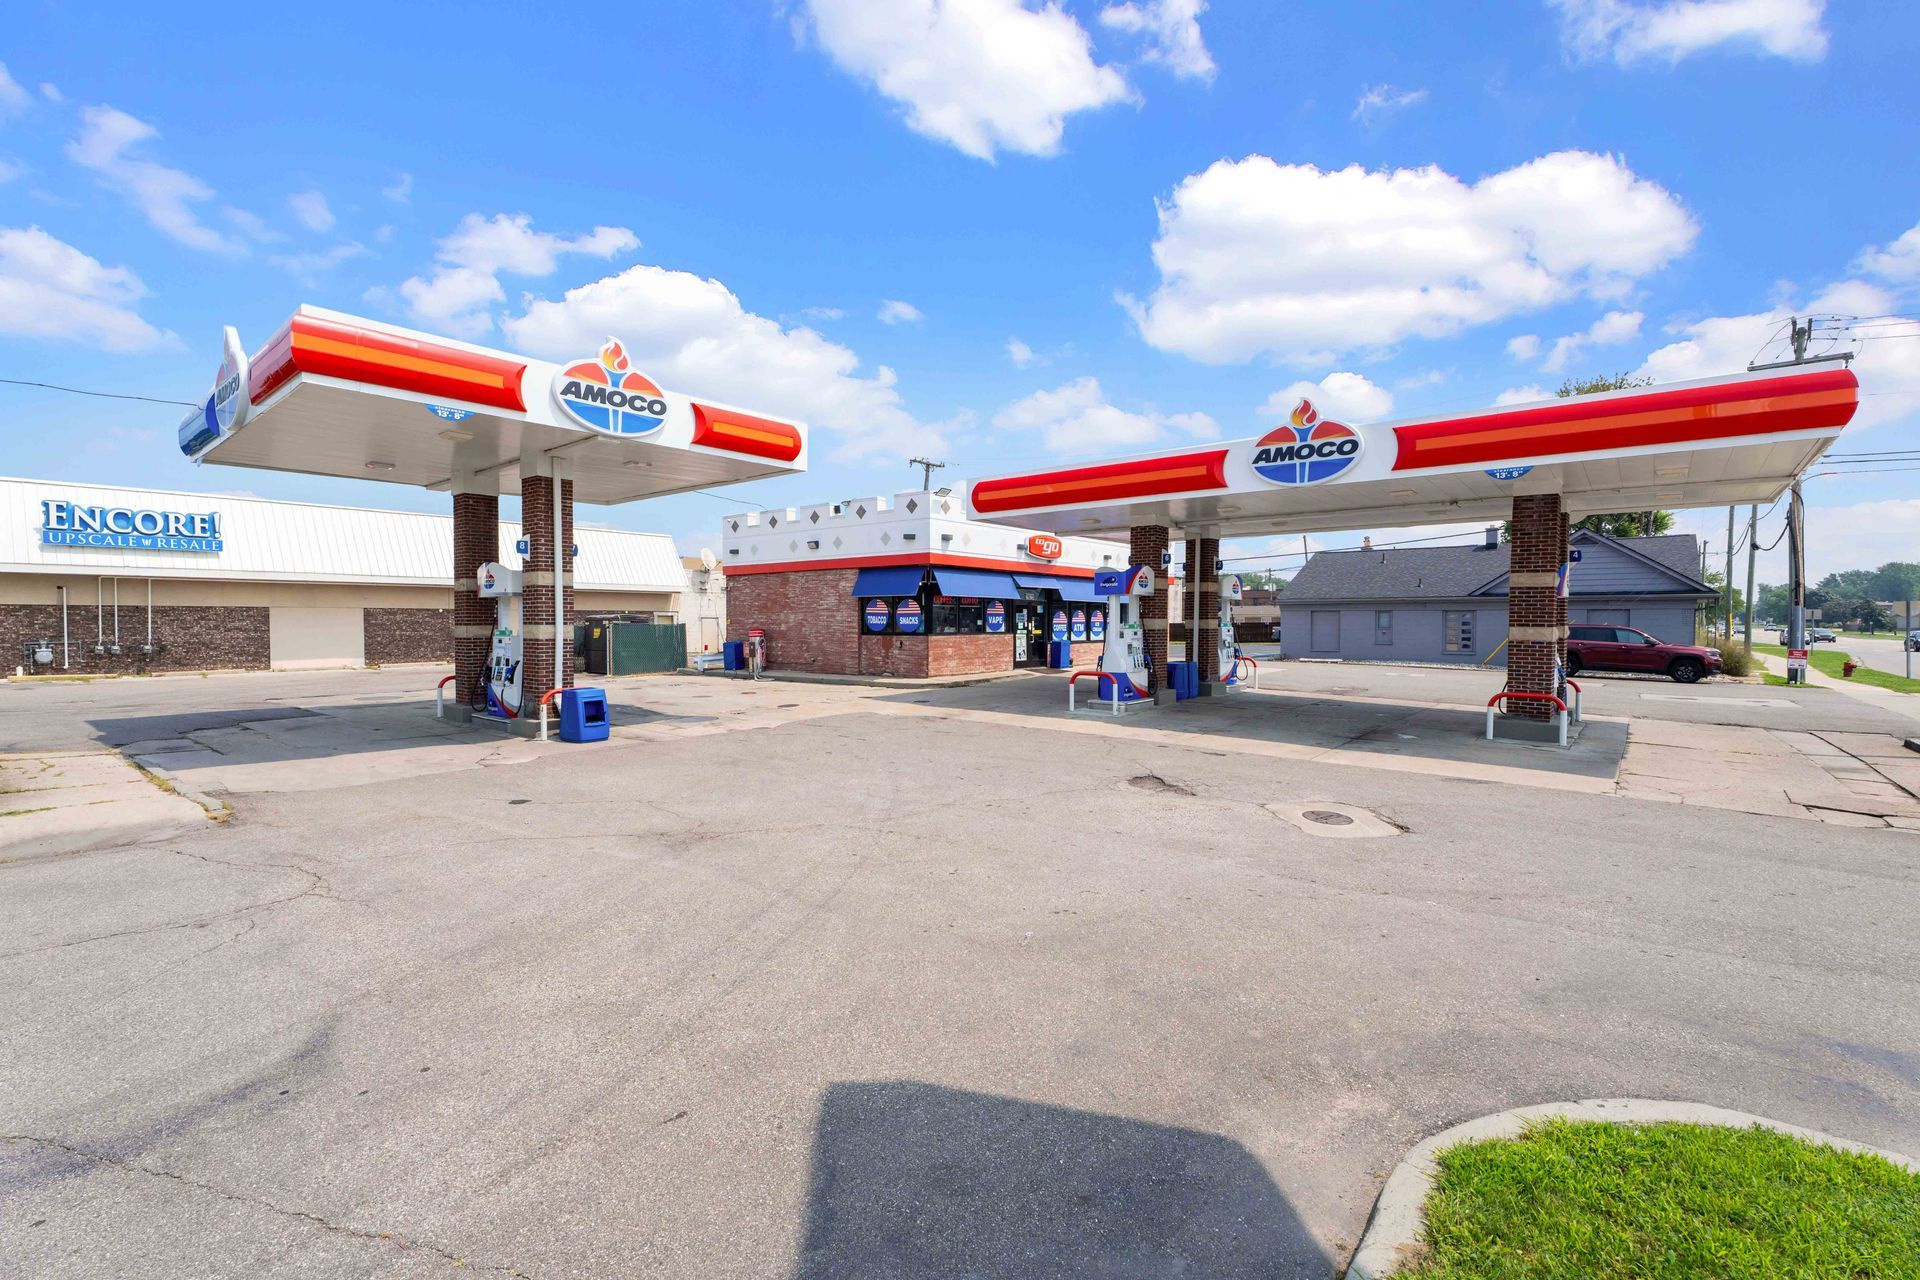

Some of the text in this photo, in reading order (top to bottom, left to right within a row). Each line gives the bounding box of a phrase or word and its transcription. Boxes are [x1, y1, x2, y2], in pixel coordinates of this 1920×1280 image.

[560, 381, 667, 415] AMOCO
[1252, 439, 1359, 464] AMOCO
[43, 500, 222, 539] ENCORE!
[49, 532, 222, 551] UPSCALE RESALE
[519, 541, 525, 549] 8
[1042, 541, 1059, 554] go
[867, 615, 887, 625] TOBACCO
[900, 616, 919, 625] SNACKS
[988, 616, 1003, 624] VAPE
[1053, 624, 1067, 632] COFFEE
[1073, 624, 1085, 632] ATM
